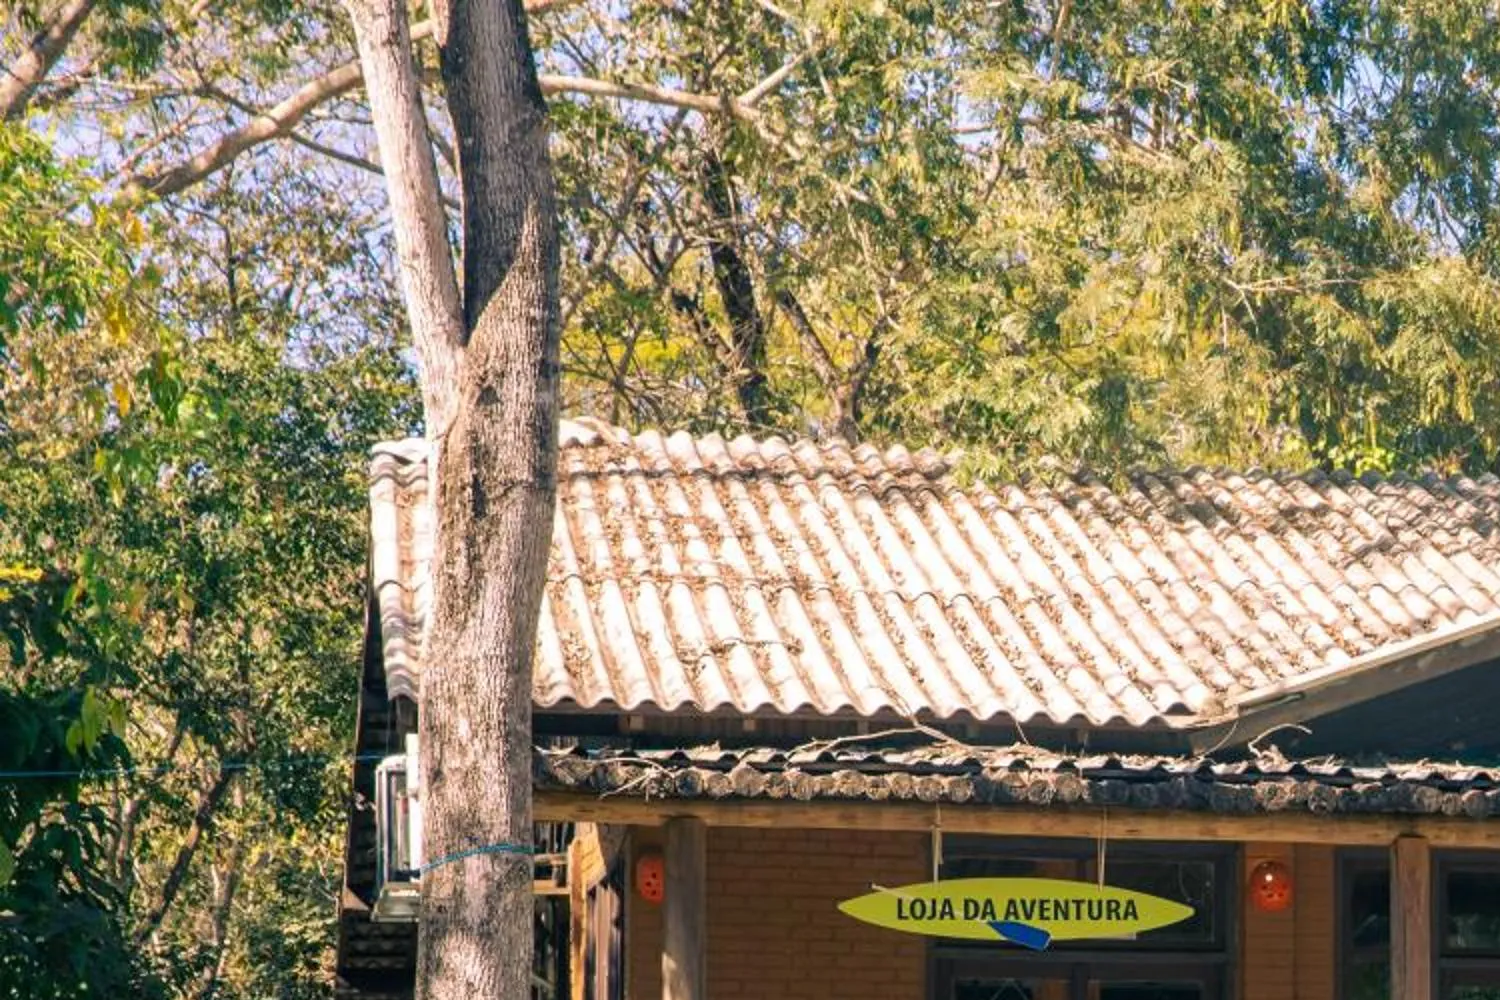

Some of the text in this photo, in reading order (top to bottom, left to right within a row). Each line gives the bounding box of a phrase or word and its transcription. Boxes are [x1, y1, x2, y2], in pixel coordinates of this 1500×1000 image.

[896, 898, 1139, 921] LOJA DA AVENTURA
